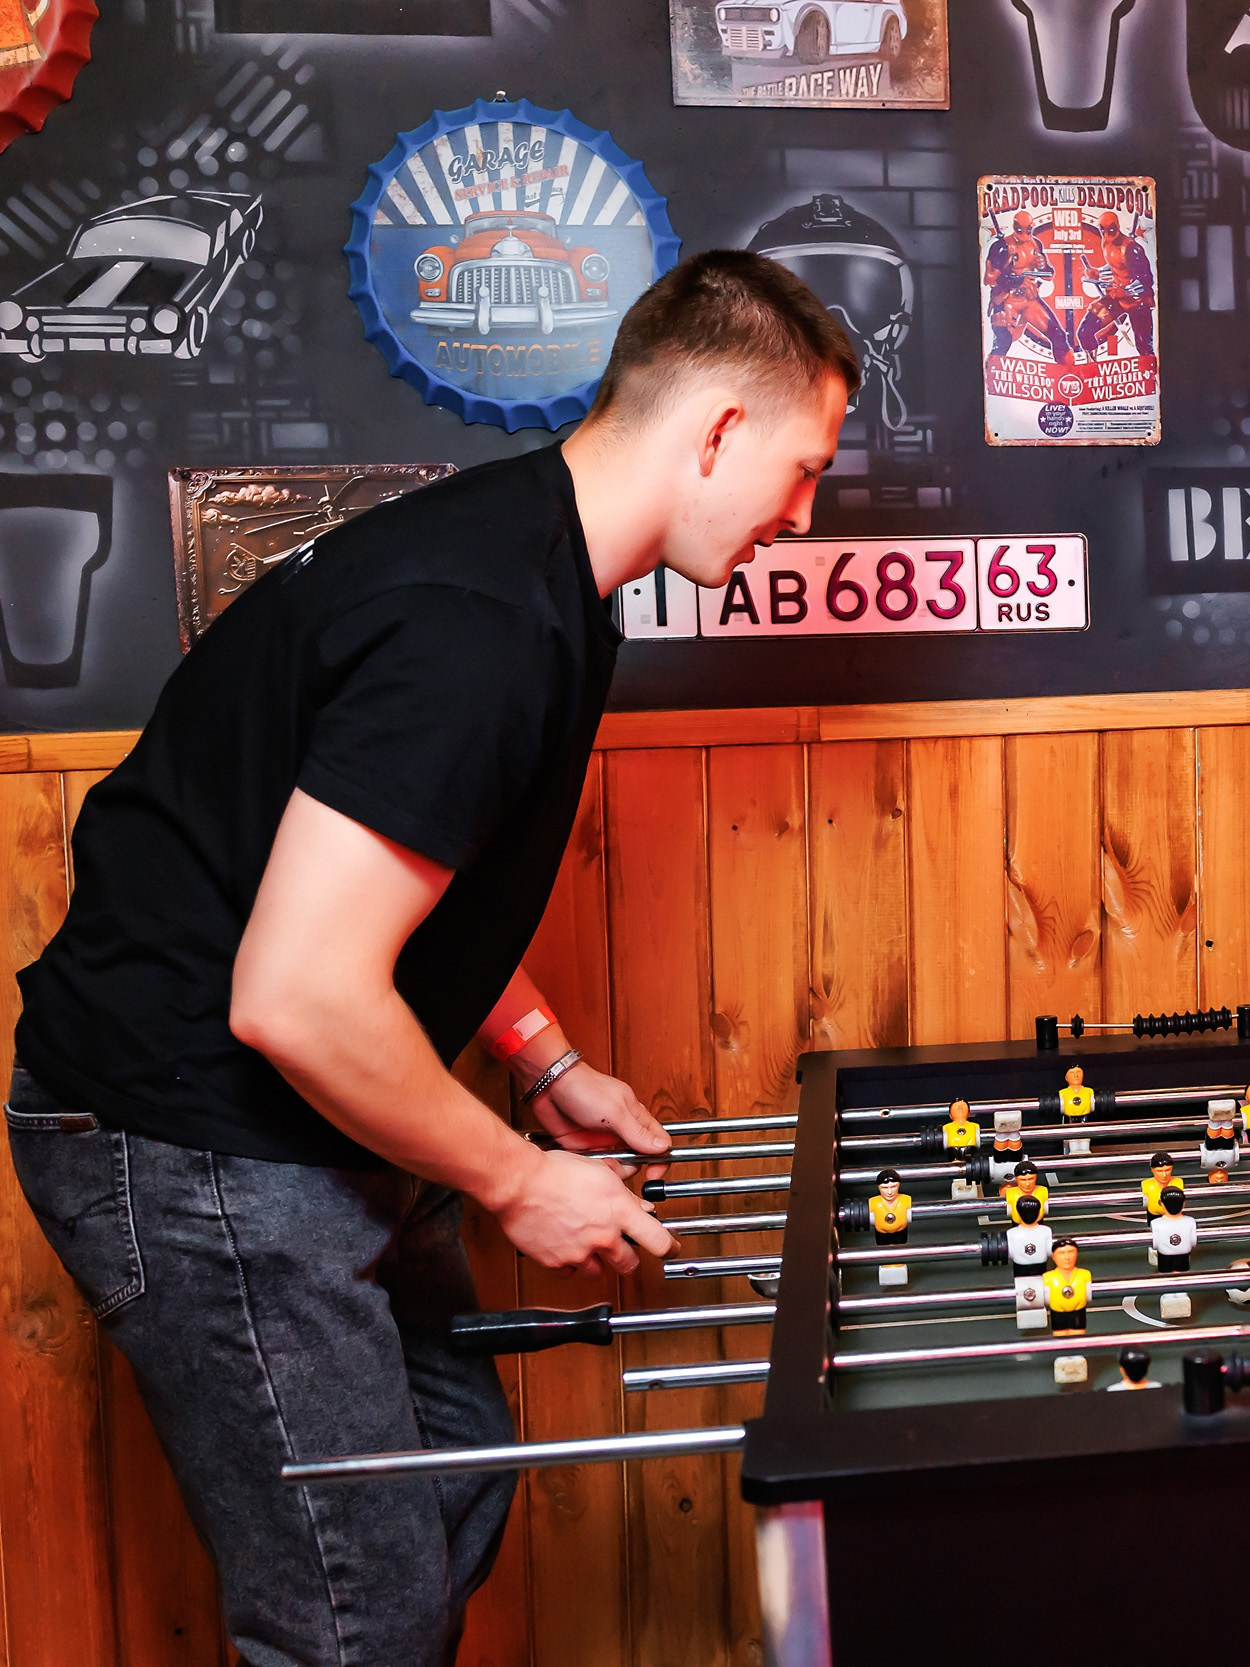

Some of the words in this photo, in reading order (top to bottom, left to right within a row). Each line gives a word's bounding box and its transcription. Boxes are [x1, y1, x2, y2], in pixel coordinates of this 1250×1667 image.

[838, 63, 882, 99] WAY
[448, 139, 545, 184] GARAGE
[454, 178, 508, 202] SERVICE
[523, 164, 569, 186] REPAIR
[981, 186, 1058, 218] DEADPOOL
[1077, 186, 1154, 219] DEADPOOL
[1053, 210, 1082, 227] WED.
[1000, 357, 1047, 377] WADE
[1097, 358, 1140, 376] WADE
[993, 379, 1054, 401] WILSON
[1091, 380, 1147, 400] WILSON
[987, 544, 1058, 598] 63
[997, 602, 1051, 623] RUS
